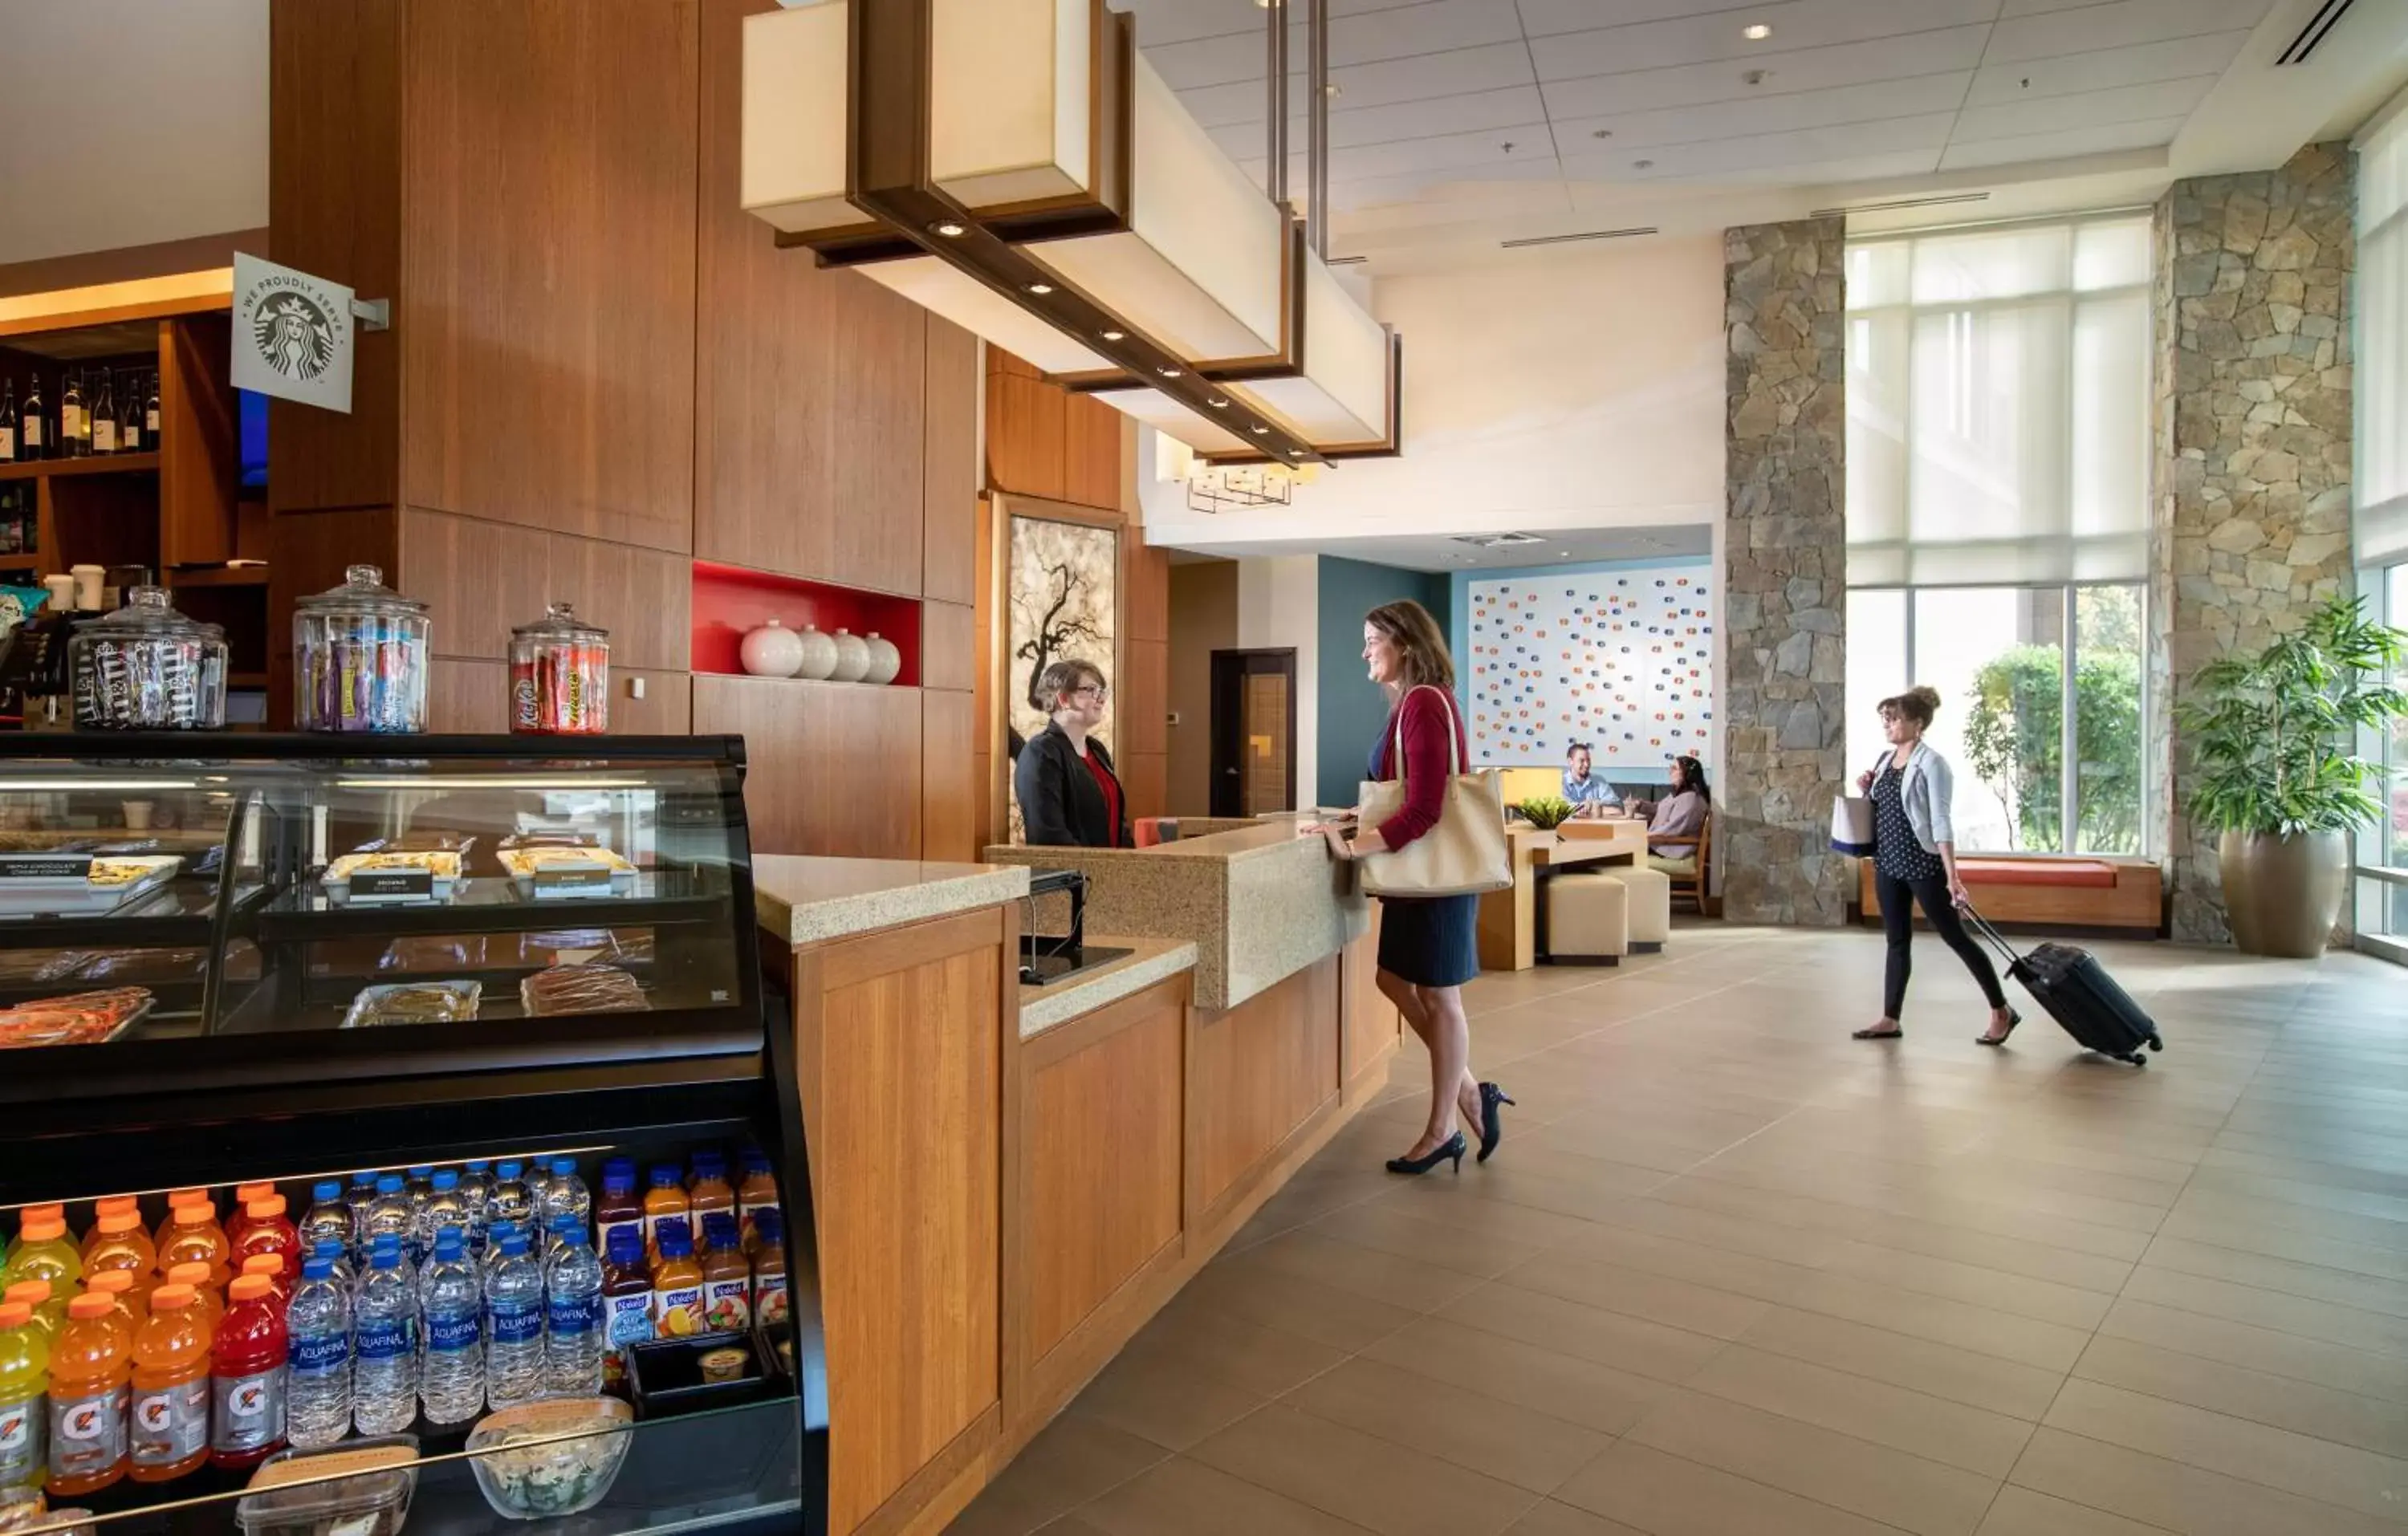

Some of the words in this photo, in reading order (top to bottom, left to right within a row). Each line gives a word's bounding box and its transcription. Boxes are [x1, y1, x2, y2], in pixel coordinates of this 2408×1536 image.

[244, 291, 258, 307] WE
[258, 275, 314, 292] PROUDLY
[316, 293, 343, 331] SERVE
[433, 1319, 478, 1339] AQUAFINA
[299, 1339, 348, 1361] AQUAFINA
[138, 1394, 171, 1432] G
[230, 1378, 265, 1416] G
[63, 1400, 102, 1440] G
